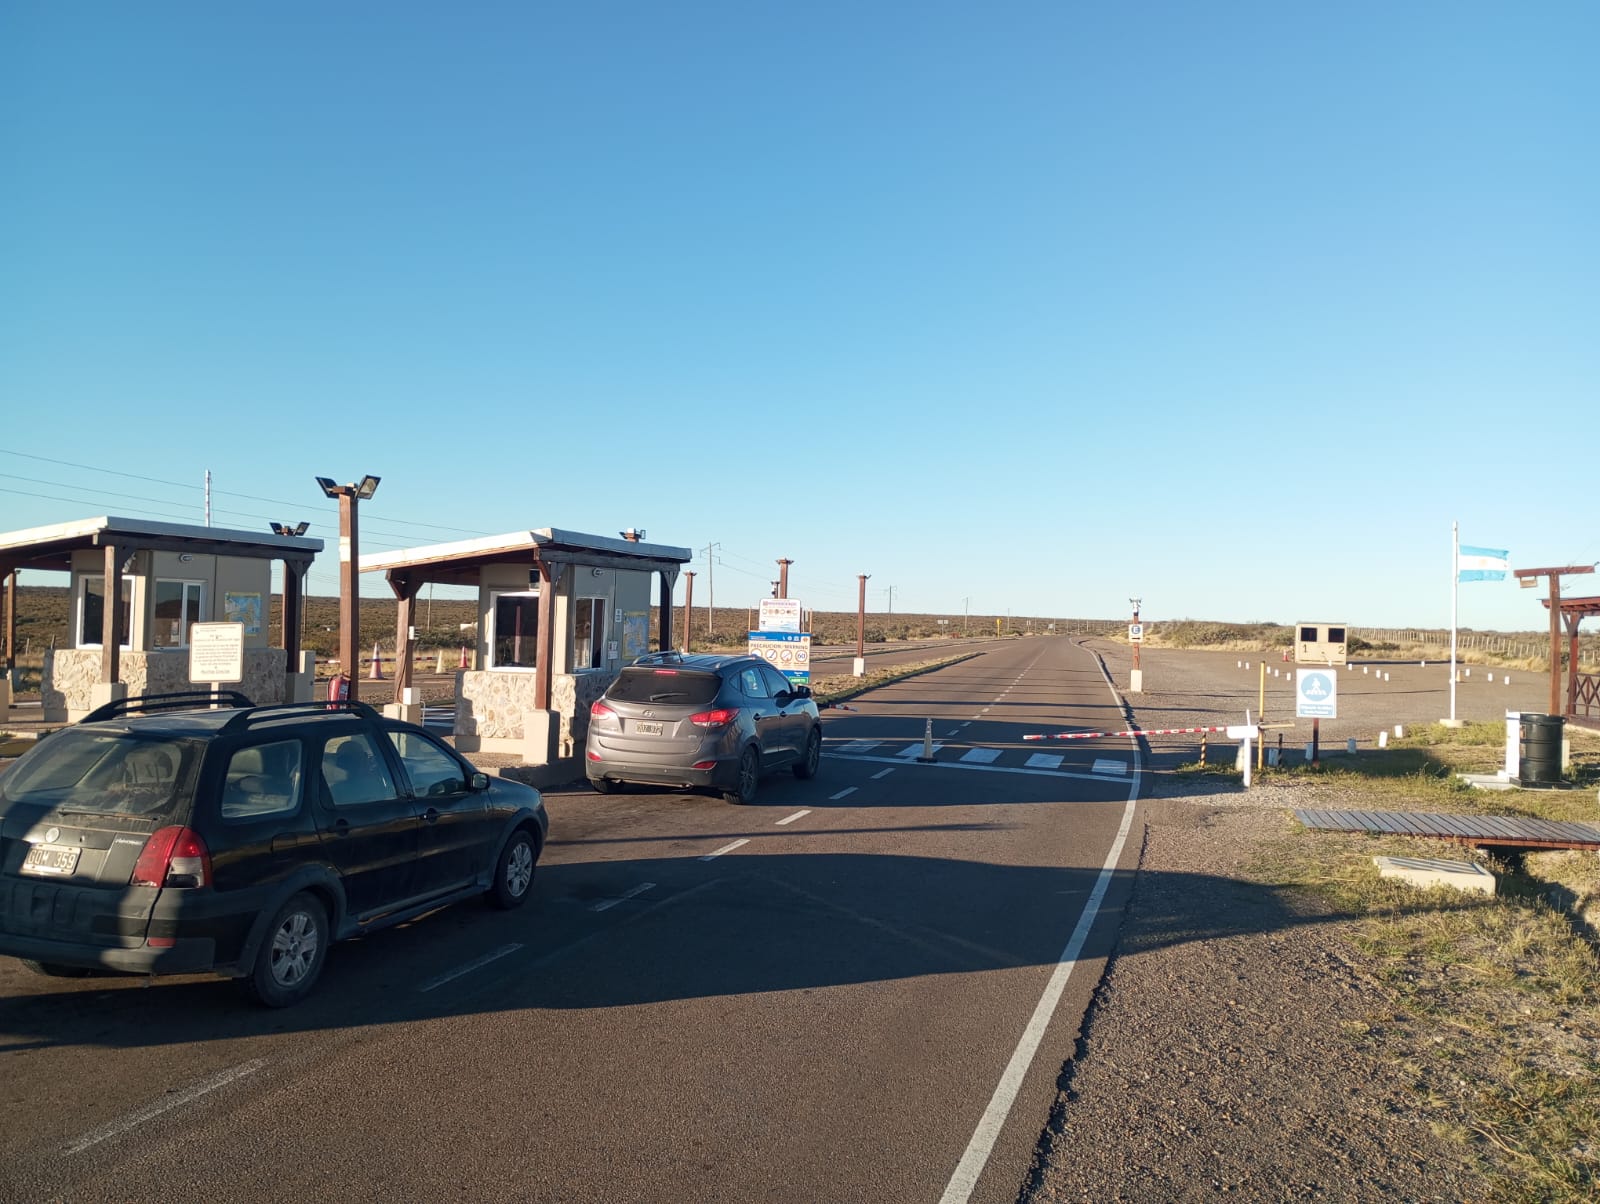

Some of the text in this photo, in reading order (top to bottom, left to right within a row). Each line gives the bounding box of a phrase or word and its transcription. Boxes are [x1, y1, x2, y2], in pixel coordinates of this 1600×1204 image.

[1303, 643, 1345, 655] 1 2
[53, 852, 76, 869] 359
